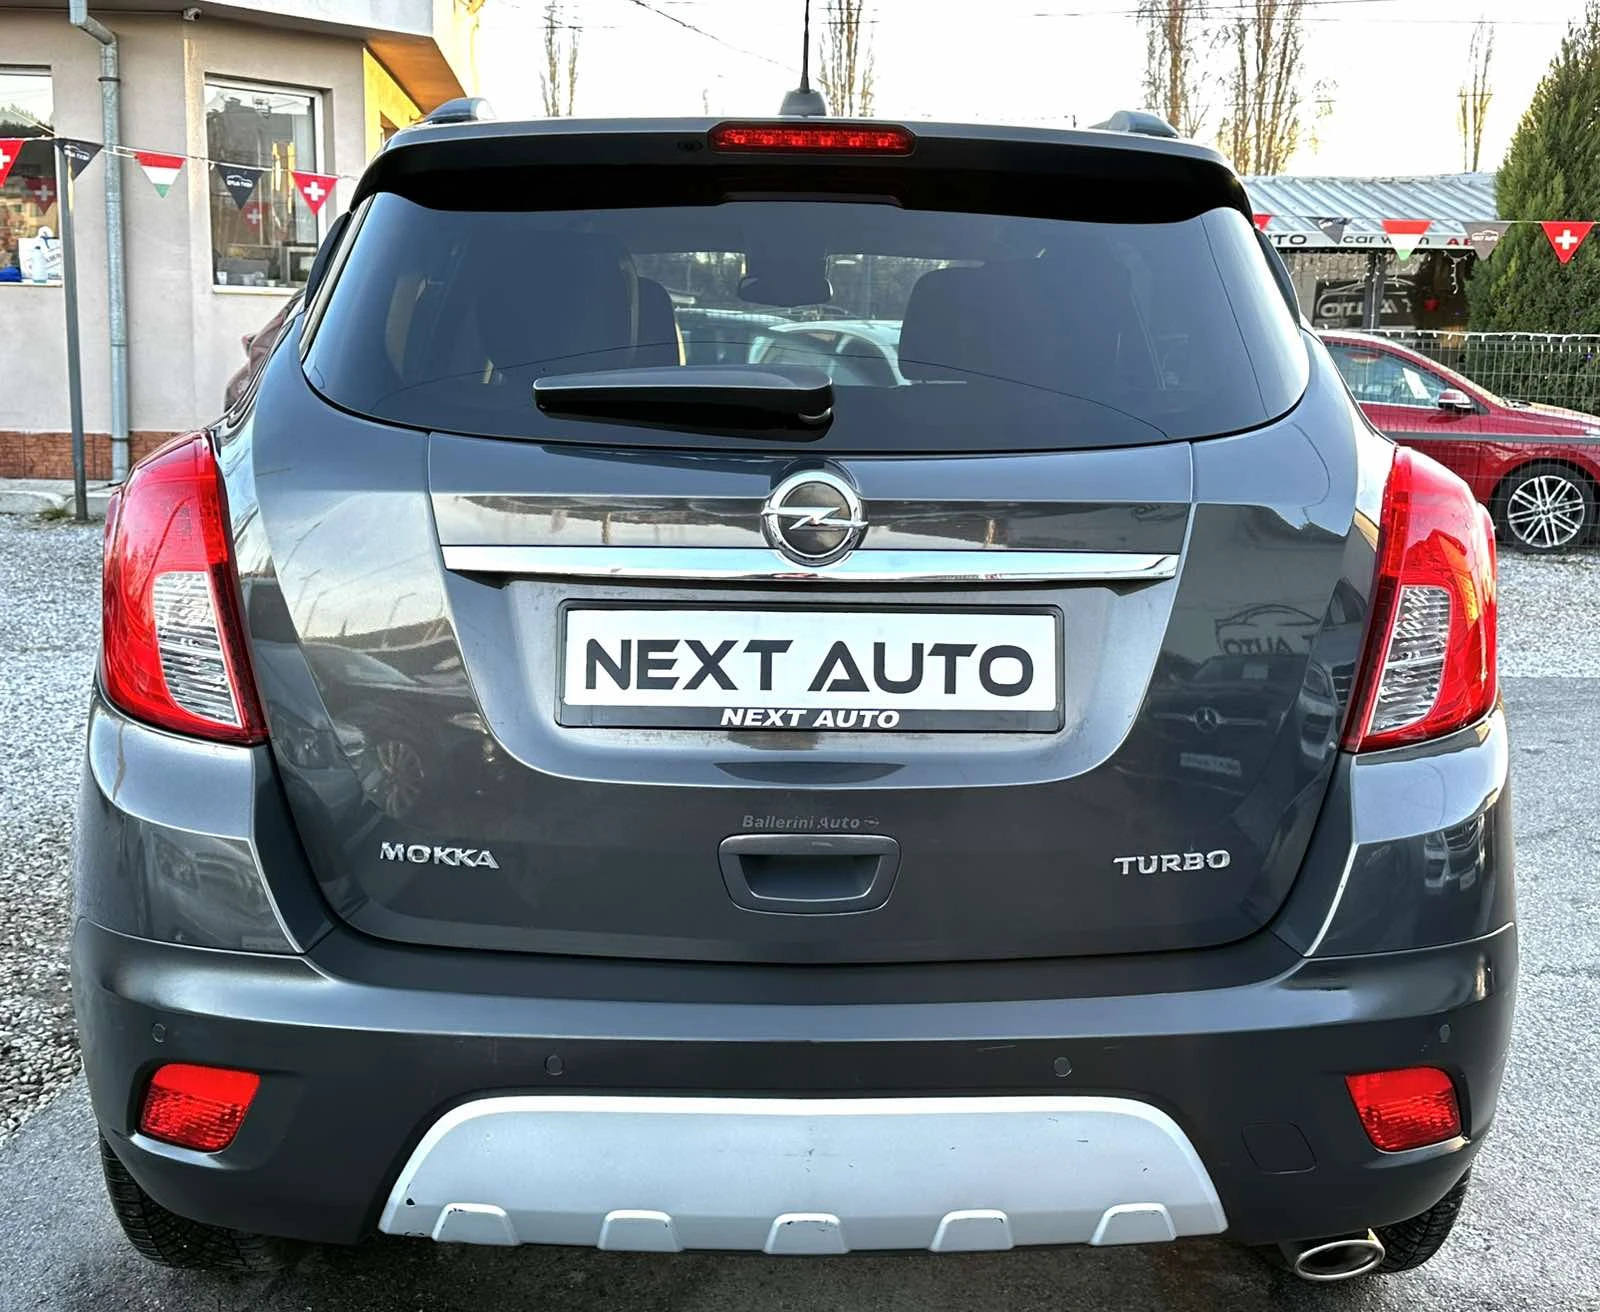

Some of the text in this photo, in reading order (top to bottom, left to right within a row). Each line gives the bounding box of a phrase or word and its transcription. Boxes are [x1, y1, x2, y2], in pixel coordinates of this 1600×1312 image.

[1343, 235, 1375, 243] car
[585, 638, 1034, 697] NEXT AUTO
[720, 708, 900, 728] NEXT AUTO
[742, 815, 860, 829] Ballerini Auto
[380, 841, 500, 869] MOKKA
[1113, 850, 1231, 875] TURBO
